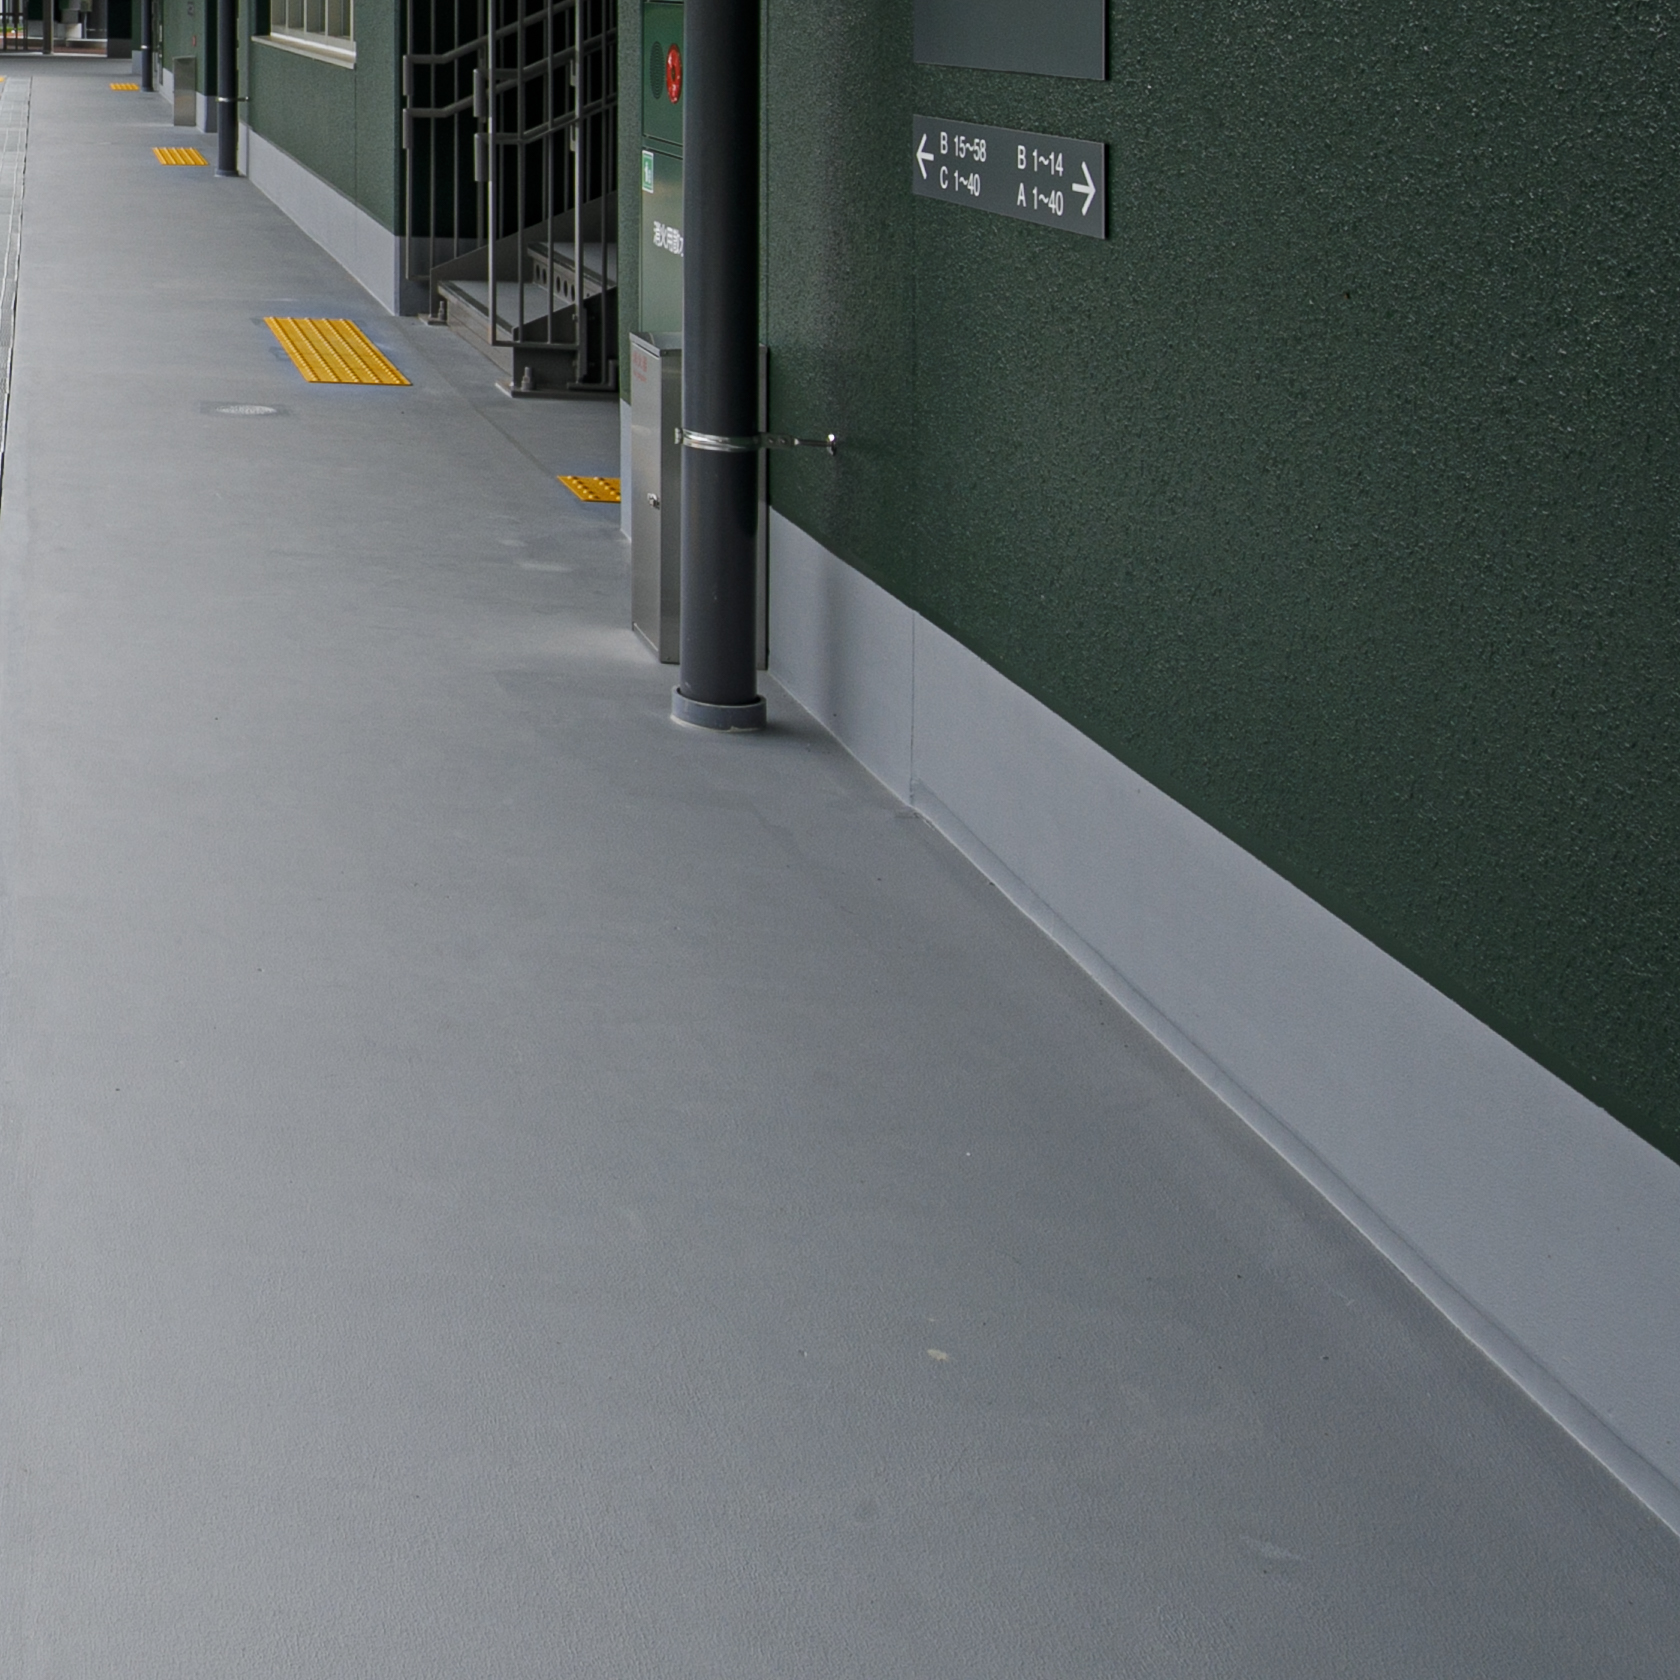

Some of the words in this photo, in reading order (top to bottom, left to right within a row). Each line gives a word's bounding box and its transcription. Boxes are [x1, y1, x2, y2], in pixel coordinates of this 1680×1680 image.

[940, 132, 948, 154] B
[954, 135, 986, 163] 15~58
[1017, 145, 1026, 170] B
[1032, 149, 1064, 177] 1~14
[939, 166, 948, 189] C
[954, 170, 981, 196] 1~40
[1017, 182, 1027, 207] A
[1032, 187, 1064, 217] 1~40
